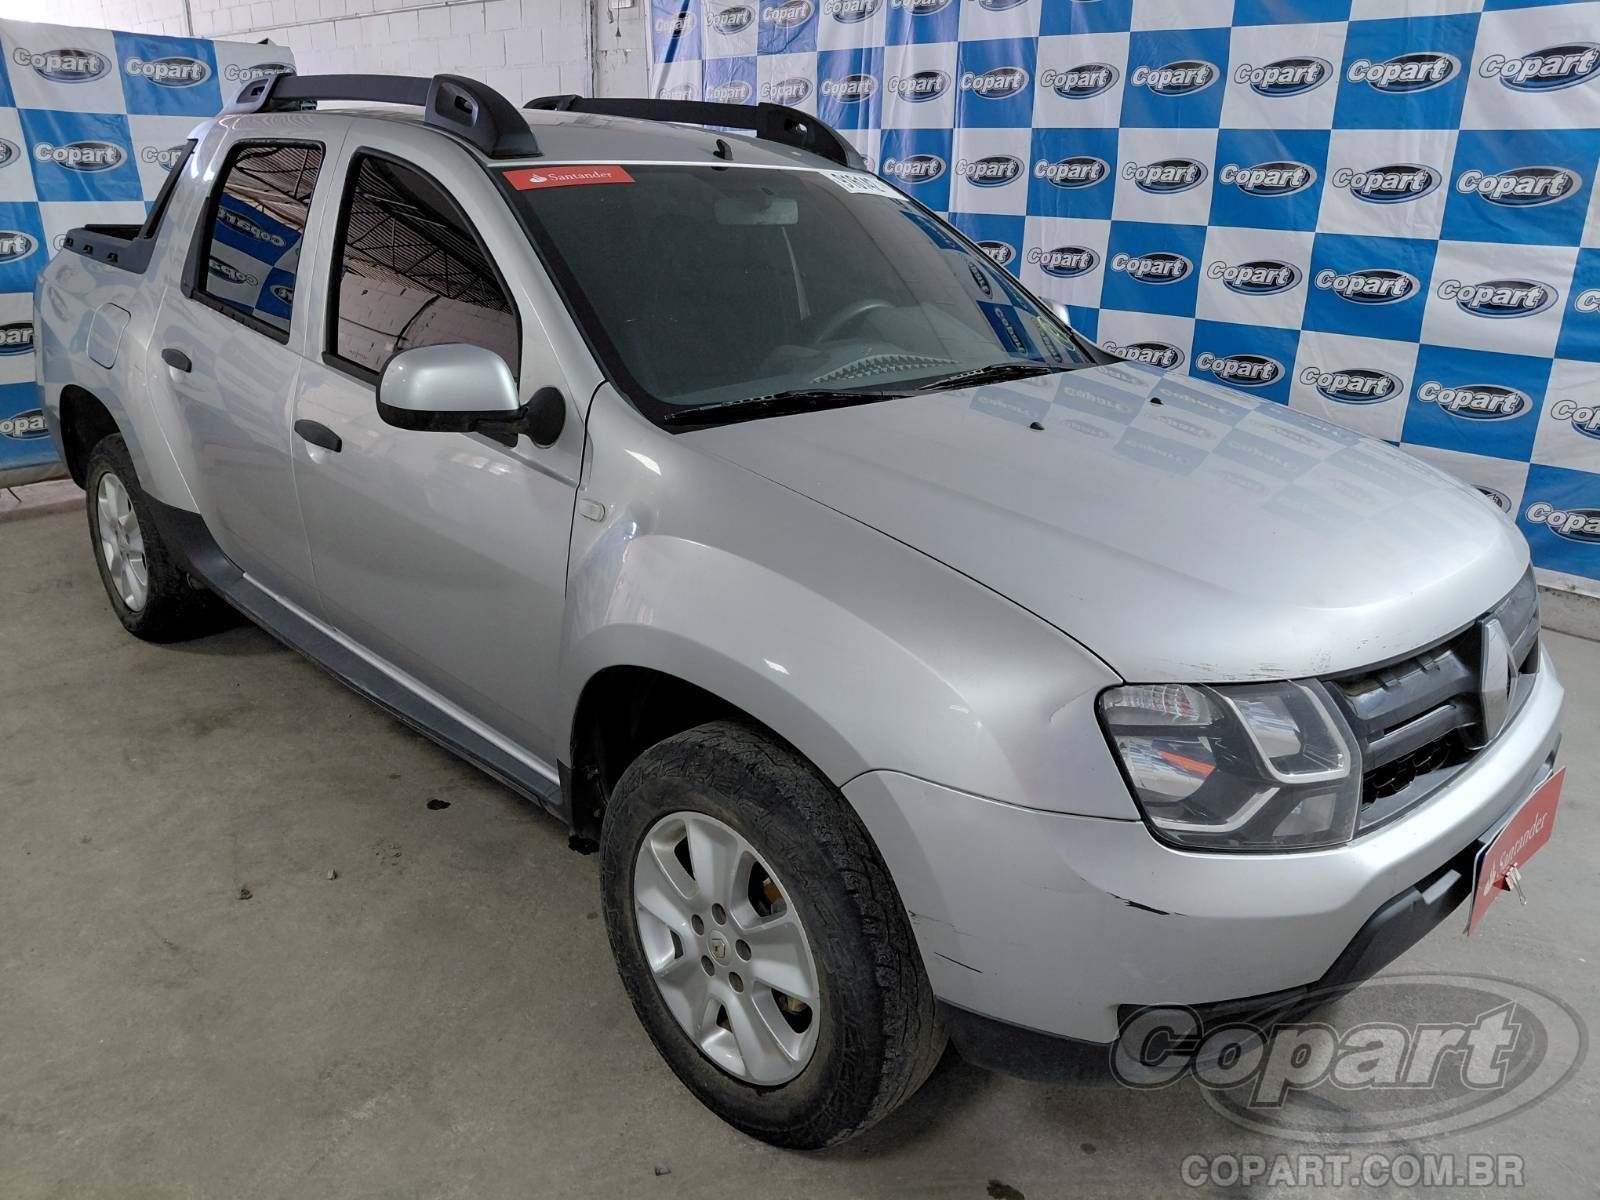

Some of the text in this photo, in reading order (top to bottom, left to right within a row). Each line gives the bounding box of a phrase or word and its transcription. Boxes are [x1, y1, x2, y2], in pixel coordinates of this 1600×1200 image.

[707, 7, 748, 28] Copart
[763, 2, 808, 22] Copart
[13, 47, 101, 74] Copart
[126, 57, 203, 81] Copart
[1234, 59, 1324, 88] Copart
[1347, 56, 1450, 87] Copart
[1478, 47, 1599, 84] Copart
[760, 80, 809, 101] Copart
[820, 79, 871, 99] Copart
[888, 74, 943, 98] Copart
[960, 70, 1022, 94] Copart
[1040, 66, 1112, 93] Copart
[1131, 64, 1212, 91] Copart
[33, 142, 116, 165] Copart
[547, 170, 613, 182] Santander
[883, 157, 938, 179] Copart
[956, 157, 1017, 181] Copart
[1034, 159, 1102, 185] Copart
[1122, 161, 1198, 187] Copart
[1220, 163, 1308, 192] Copart
[1332, 168, 1430, 193] Copart
[1456, 169, 1570, 199] Copart
[1027, 247, 1093, 271] Copart
[1111, 252, 1186, 279] Copart
[1207, 260, 1291, 288] Copart
[1314, 268, 1411, 298] Copart
[1437, 279, 1544, 309] Copart
[1196, 351, 1275, 381] Copart
[1300, 366, 1393, 396] Copart
[1417, 380, 1525, 415] Copart
